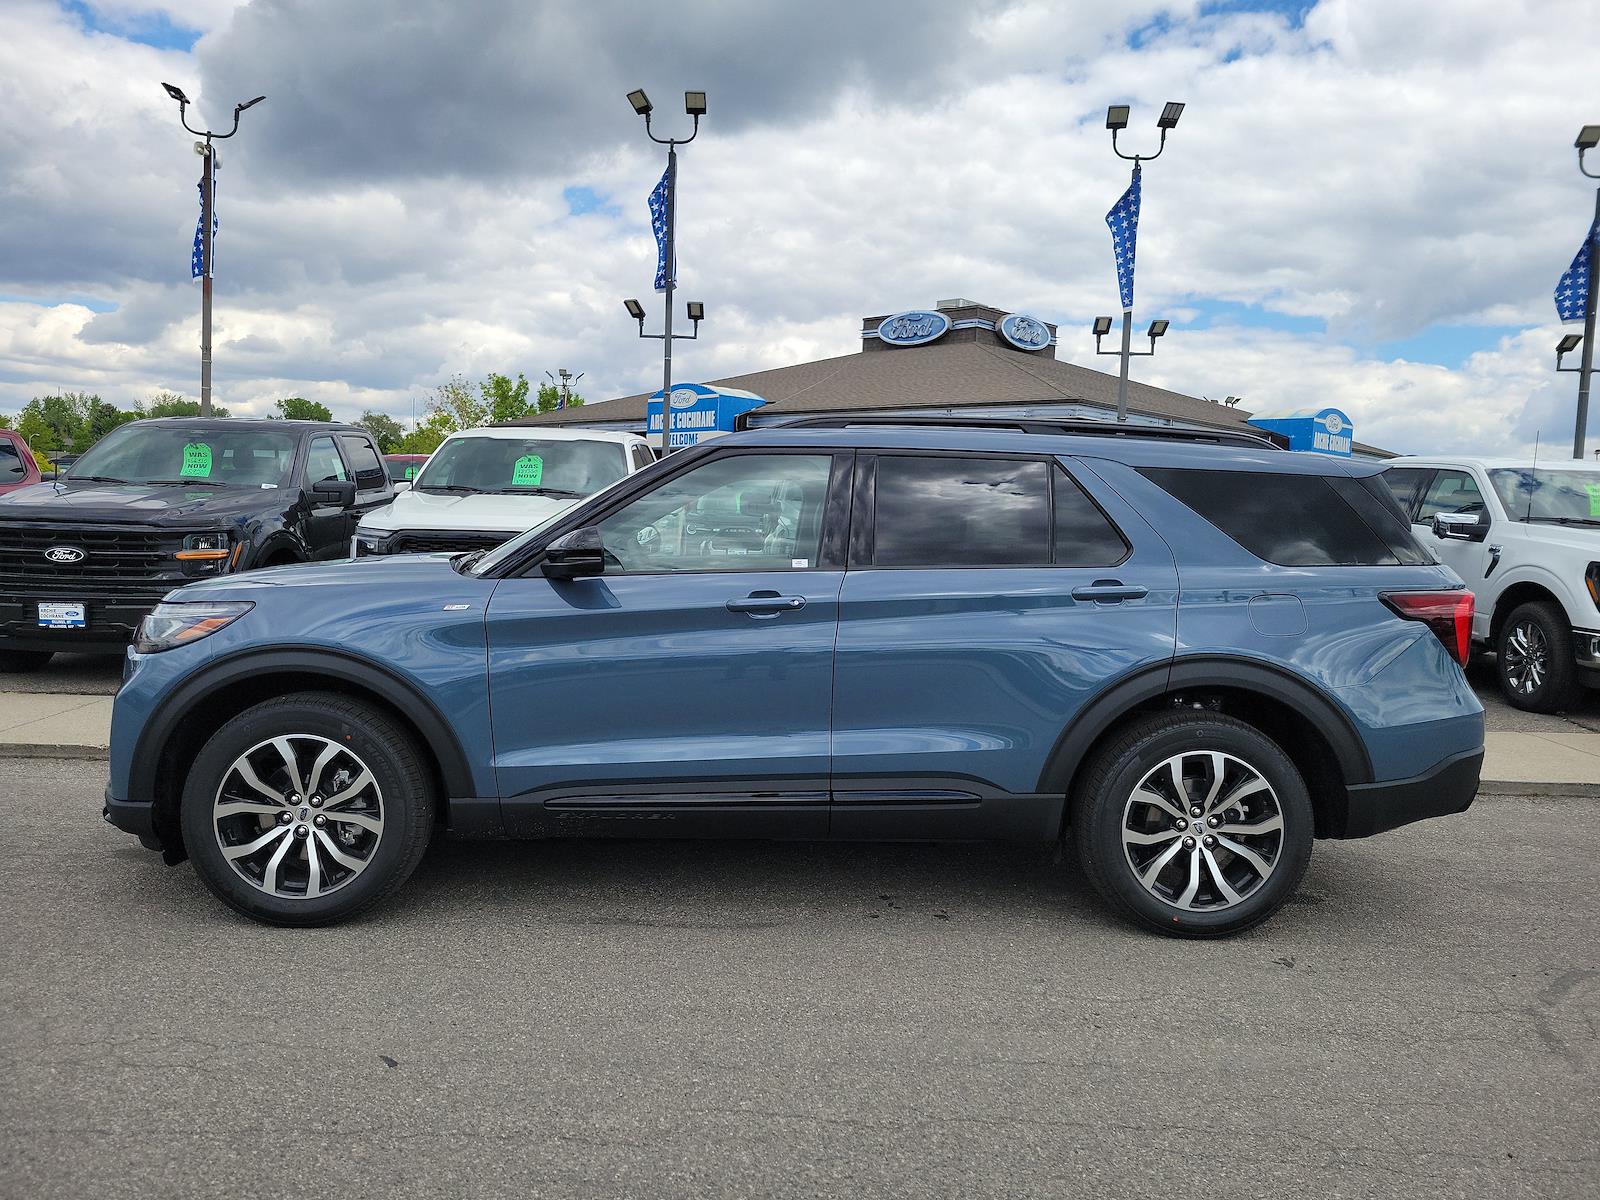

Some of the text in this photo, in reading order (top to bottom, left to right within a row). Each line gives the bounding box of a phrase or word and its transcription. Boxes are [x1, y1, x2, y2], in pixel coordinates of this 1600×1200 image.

[888, 314, 933, 339] Ford
[1012, 317, 1041, 344] Ford
[673, 392, 691, 403] Ford
[650, 411, 715, 429] ARCIE COCHRANE
[669, 434, 698, 445] ELCOME
[52, 549, 77, 560] Ford
